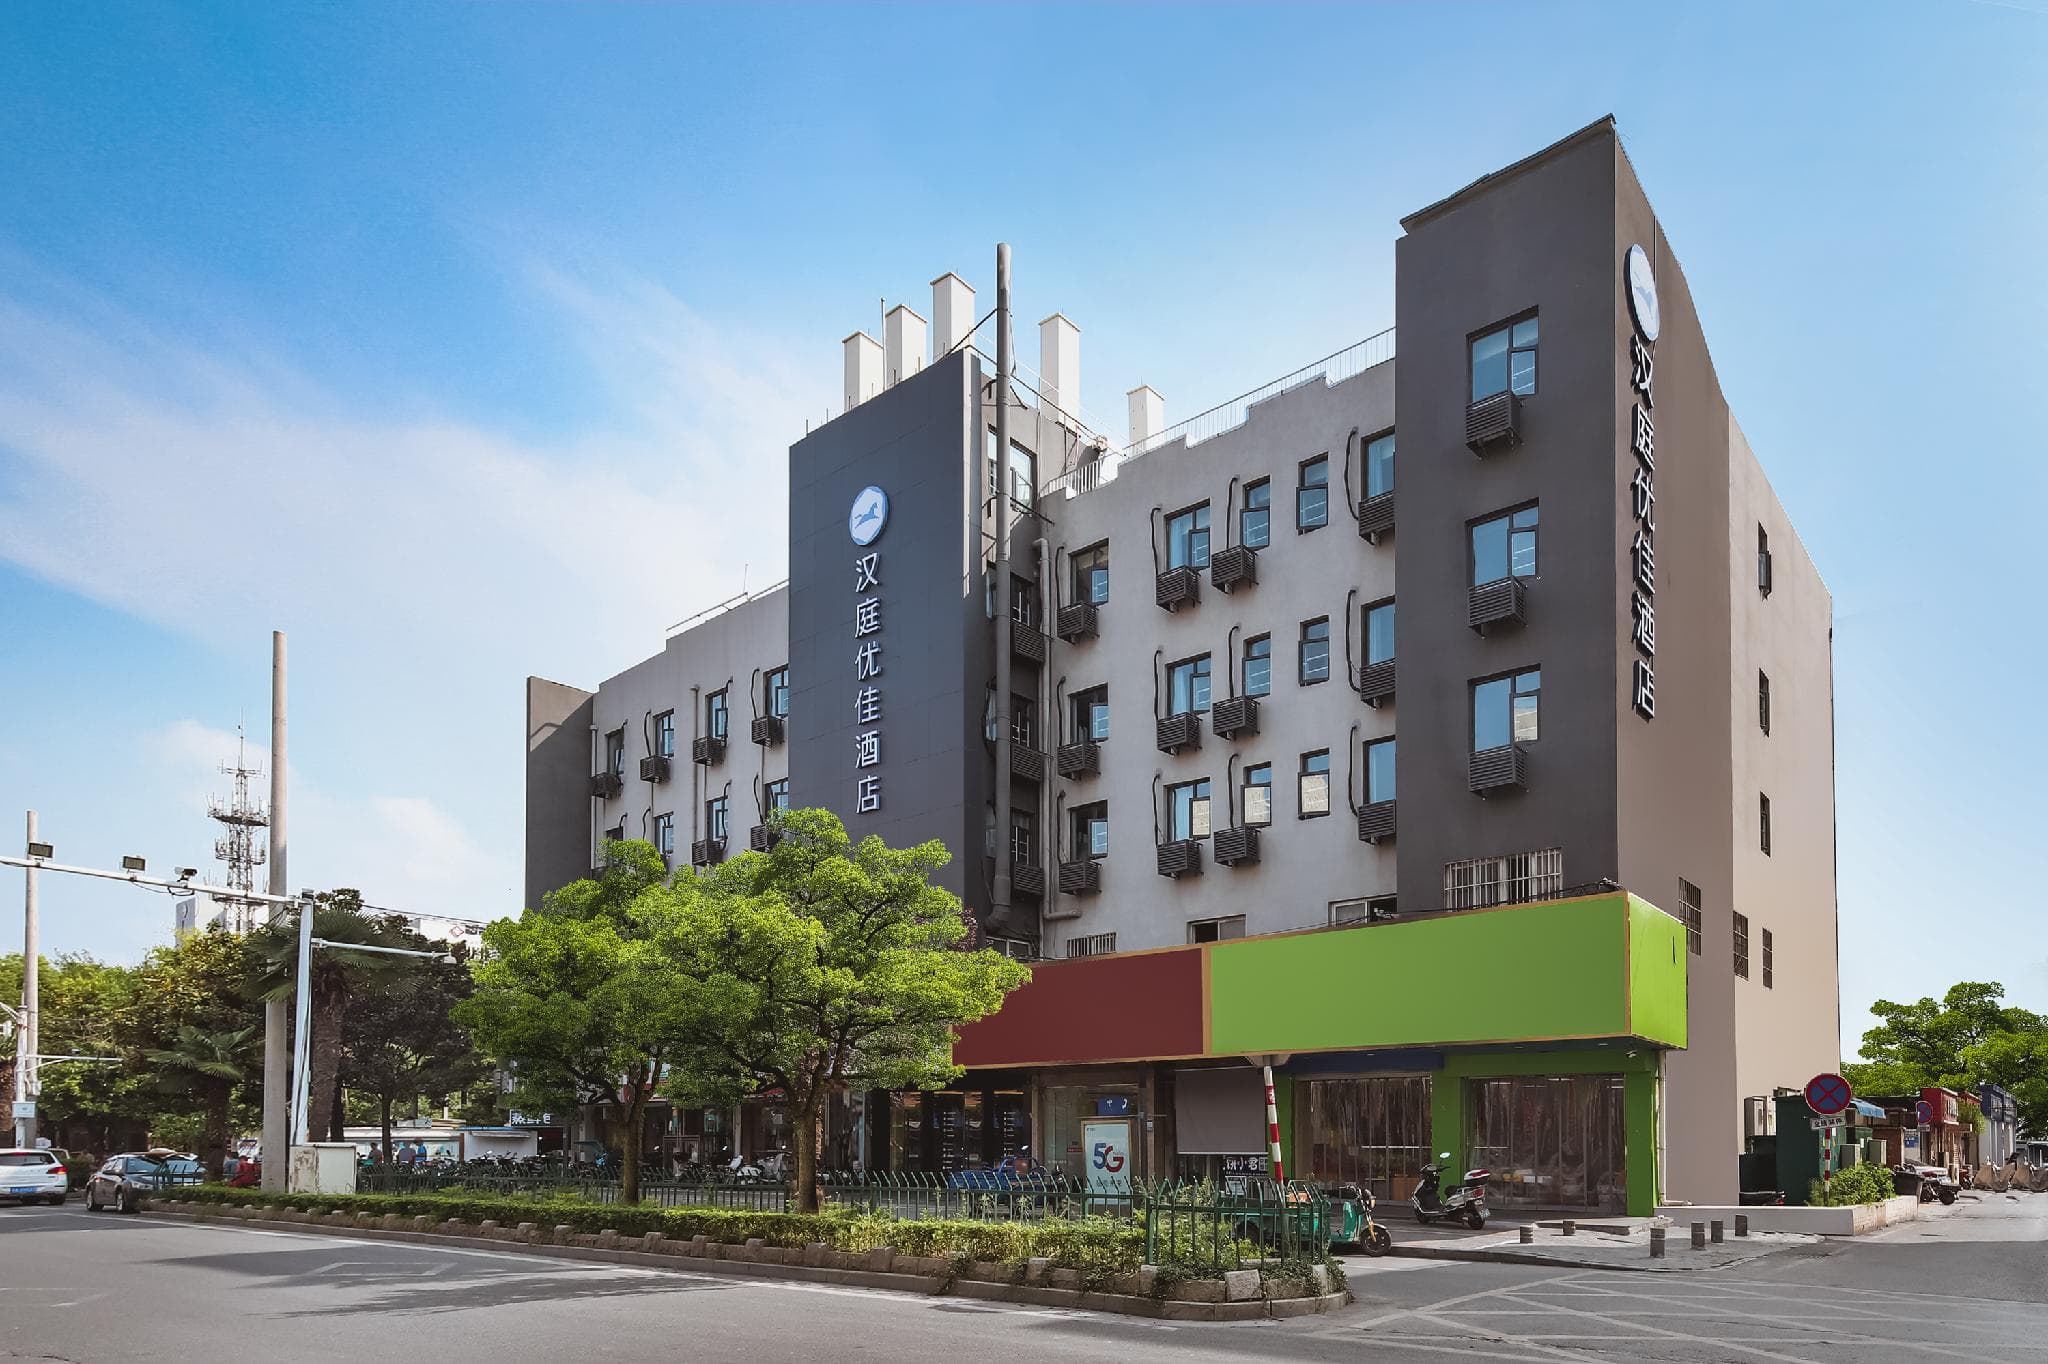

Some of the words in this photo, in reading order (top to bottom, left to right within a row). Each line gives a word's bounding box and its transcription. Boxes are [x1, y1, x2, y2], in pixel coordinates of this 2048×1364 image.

[1632, 334, 1656, 720] 汉庭优佳酒店
[855, 552, 881, 814] 汉庭优佳酒店
[1093, 1142, 1125, 1173] 5G
